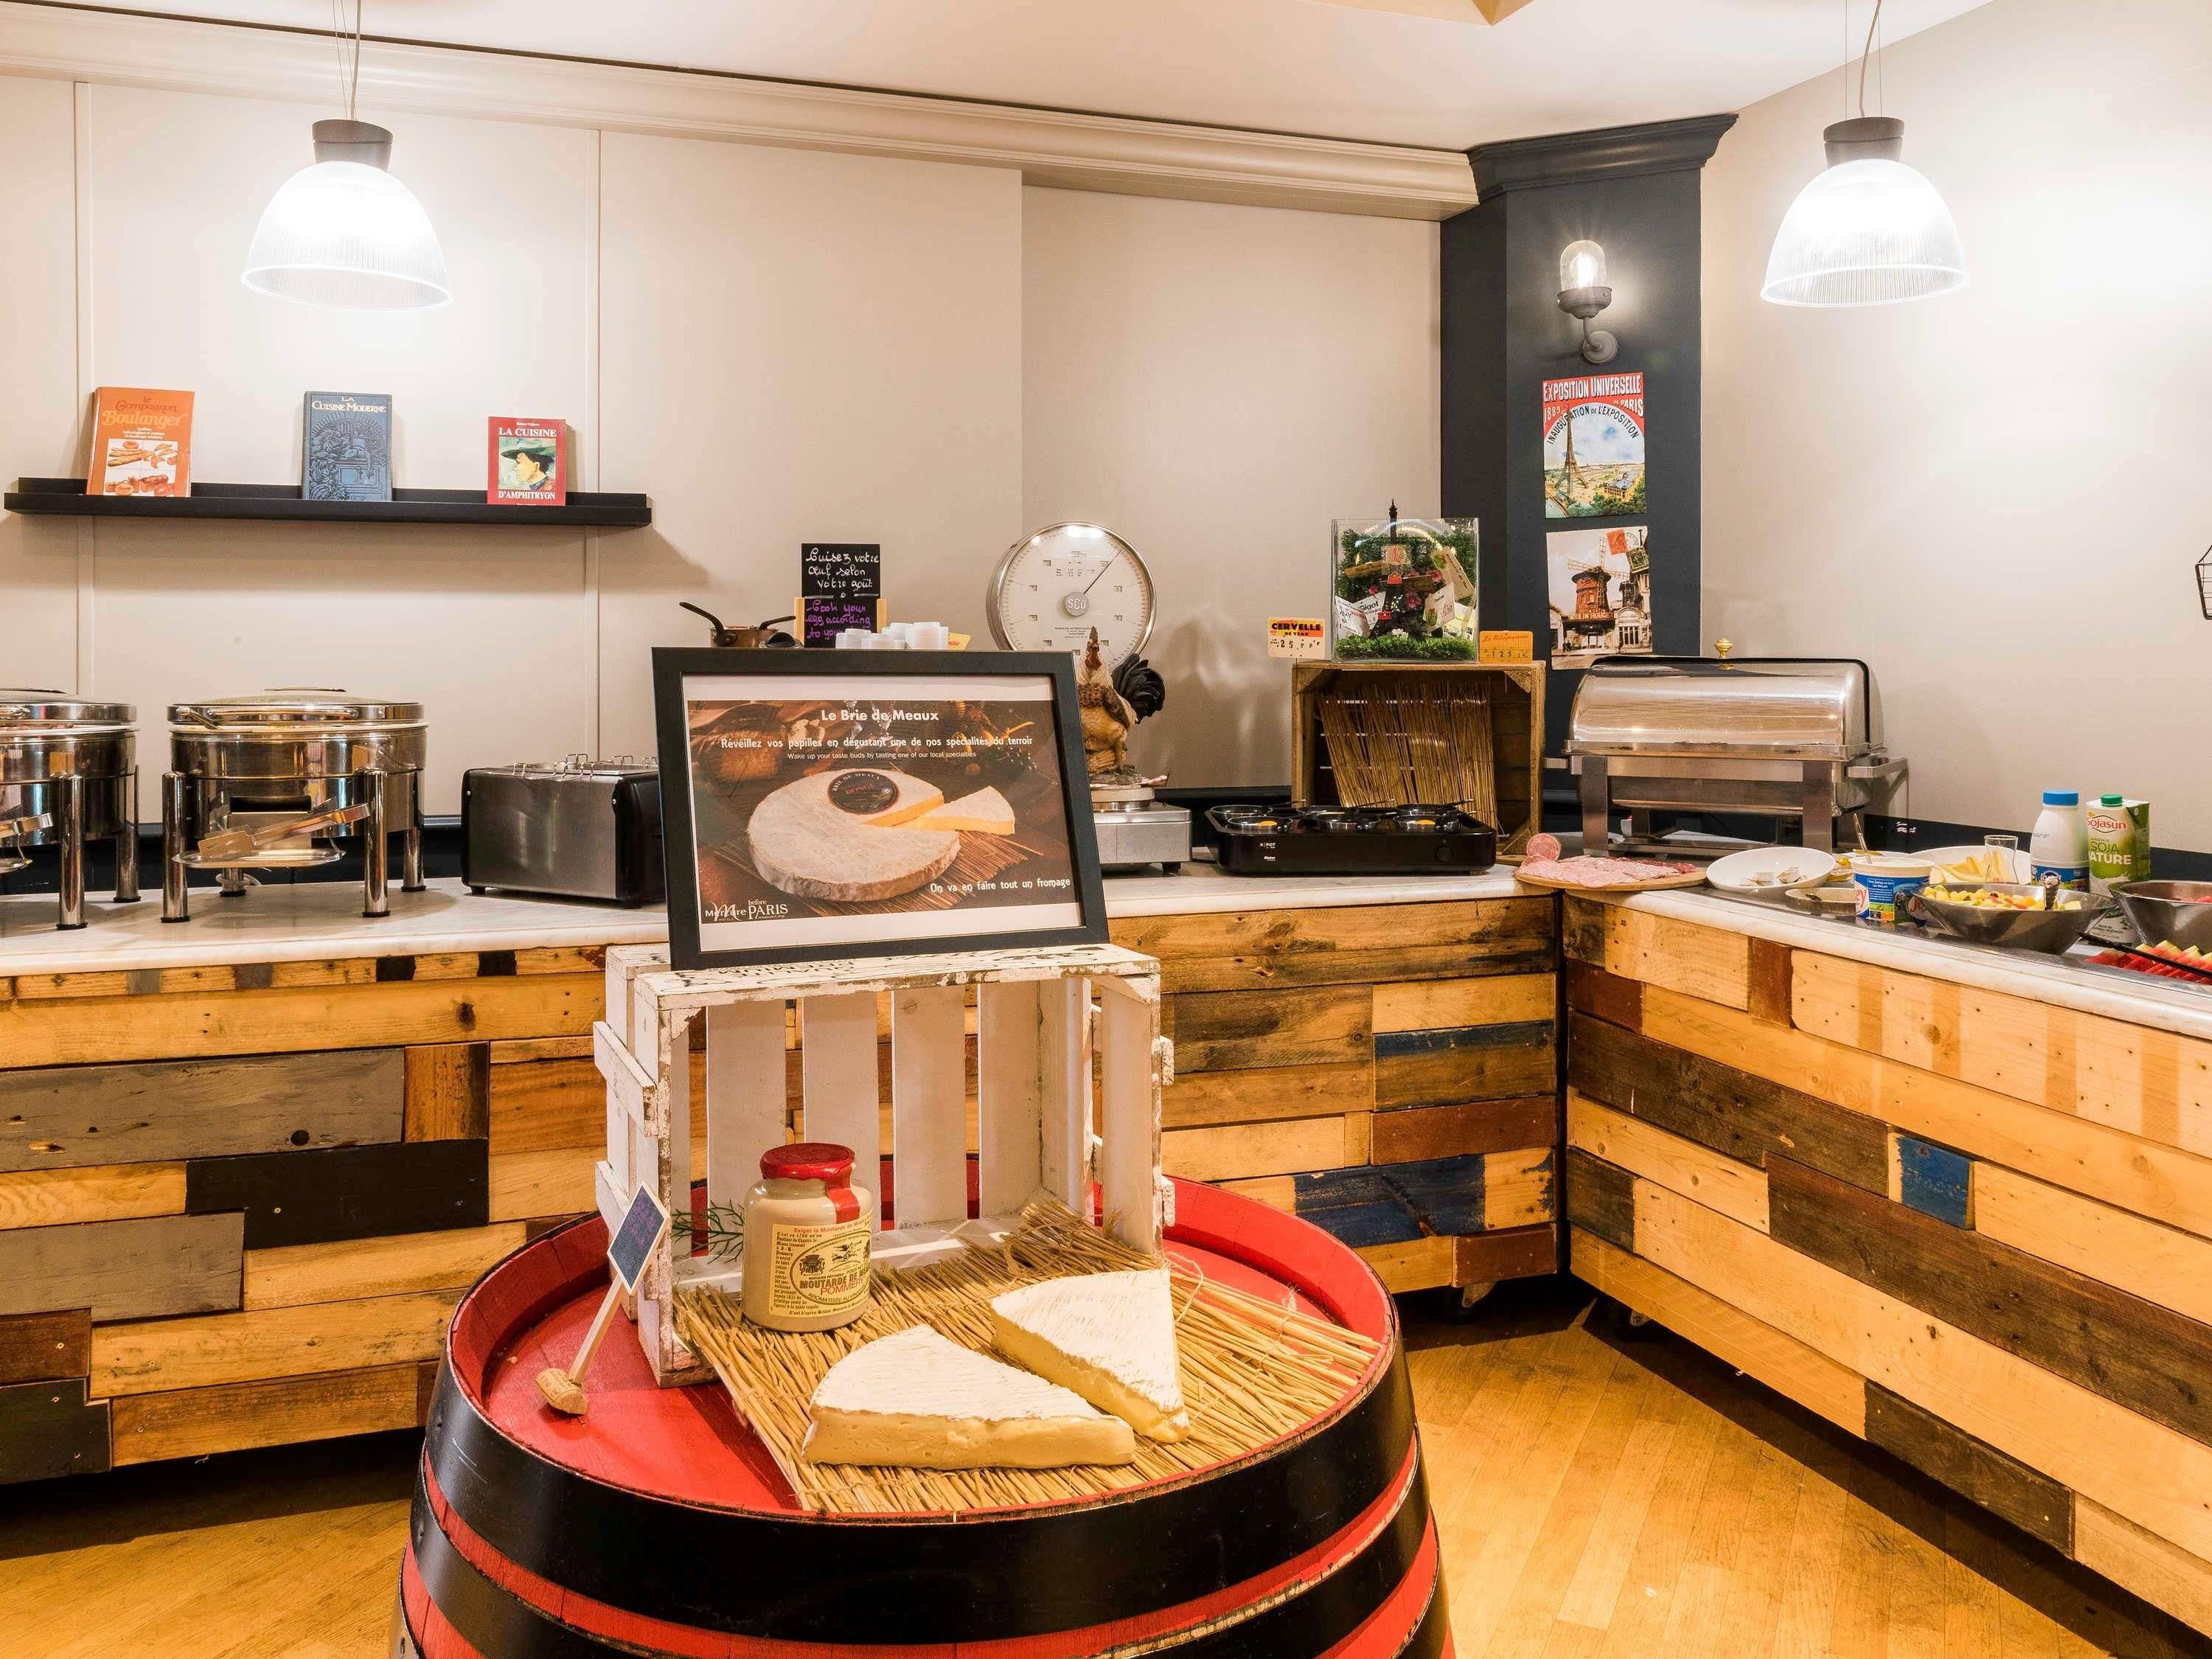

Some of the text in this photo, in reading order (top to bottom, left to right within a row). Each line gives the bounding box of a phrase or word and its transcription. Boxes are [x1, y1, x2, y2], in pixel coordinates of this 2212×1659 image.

[1544, 375, 1641, 402] EXPOSITION UNIVERSELLE
[1621, 398, 1644, 417] PARIS
[102, 410, 188, 429] Boulanger
[498, 427, 557, 437] LA CUISINE
[498, 490, 555, 499] D'AMPHITRYON
[855, 552, 879, 563] votre
[836, 564, 865, 576] selon
[818, 578, 846, 588] votre
[1271, 622, 1321, 630] CERVELLE
[821, 709, 939, 721] Le Brie de Meaux
[721, 738, 762, 748] Réveillez
[788, 738, 822, 749] papilles
[827, 740, 838, 748] en
[843, 737, 886, 748] dégustant
[911, 737, 921, 746] de
[946, 737, 988, 748] spécialités
[993, 737, 1004, 745] du
[1008, 736, 1032, 745] terroir
[2090, 841, 2119, 854] SOJA
[930, 883, 942, 893] On
[962, 884, 972, 893] en
[977, 881, 995, 891] faire
[1000, 880, 1018, 889] tout
[1023, 881, 1032, 889] un
[1037, 877, 1071, 888] fromage
[748, 904, 788, 919] PARIS
[800, 1272, 858, 1289] MOUTARDE DE
[820, 1277, 865, 1295] POMMERY
